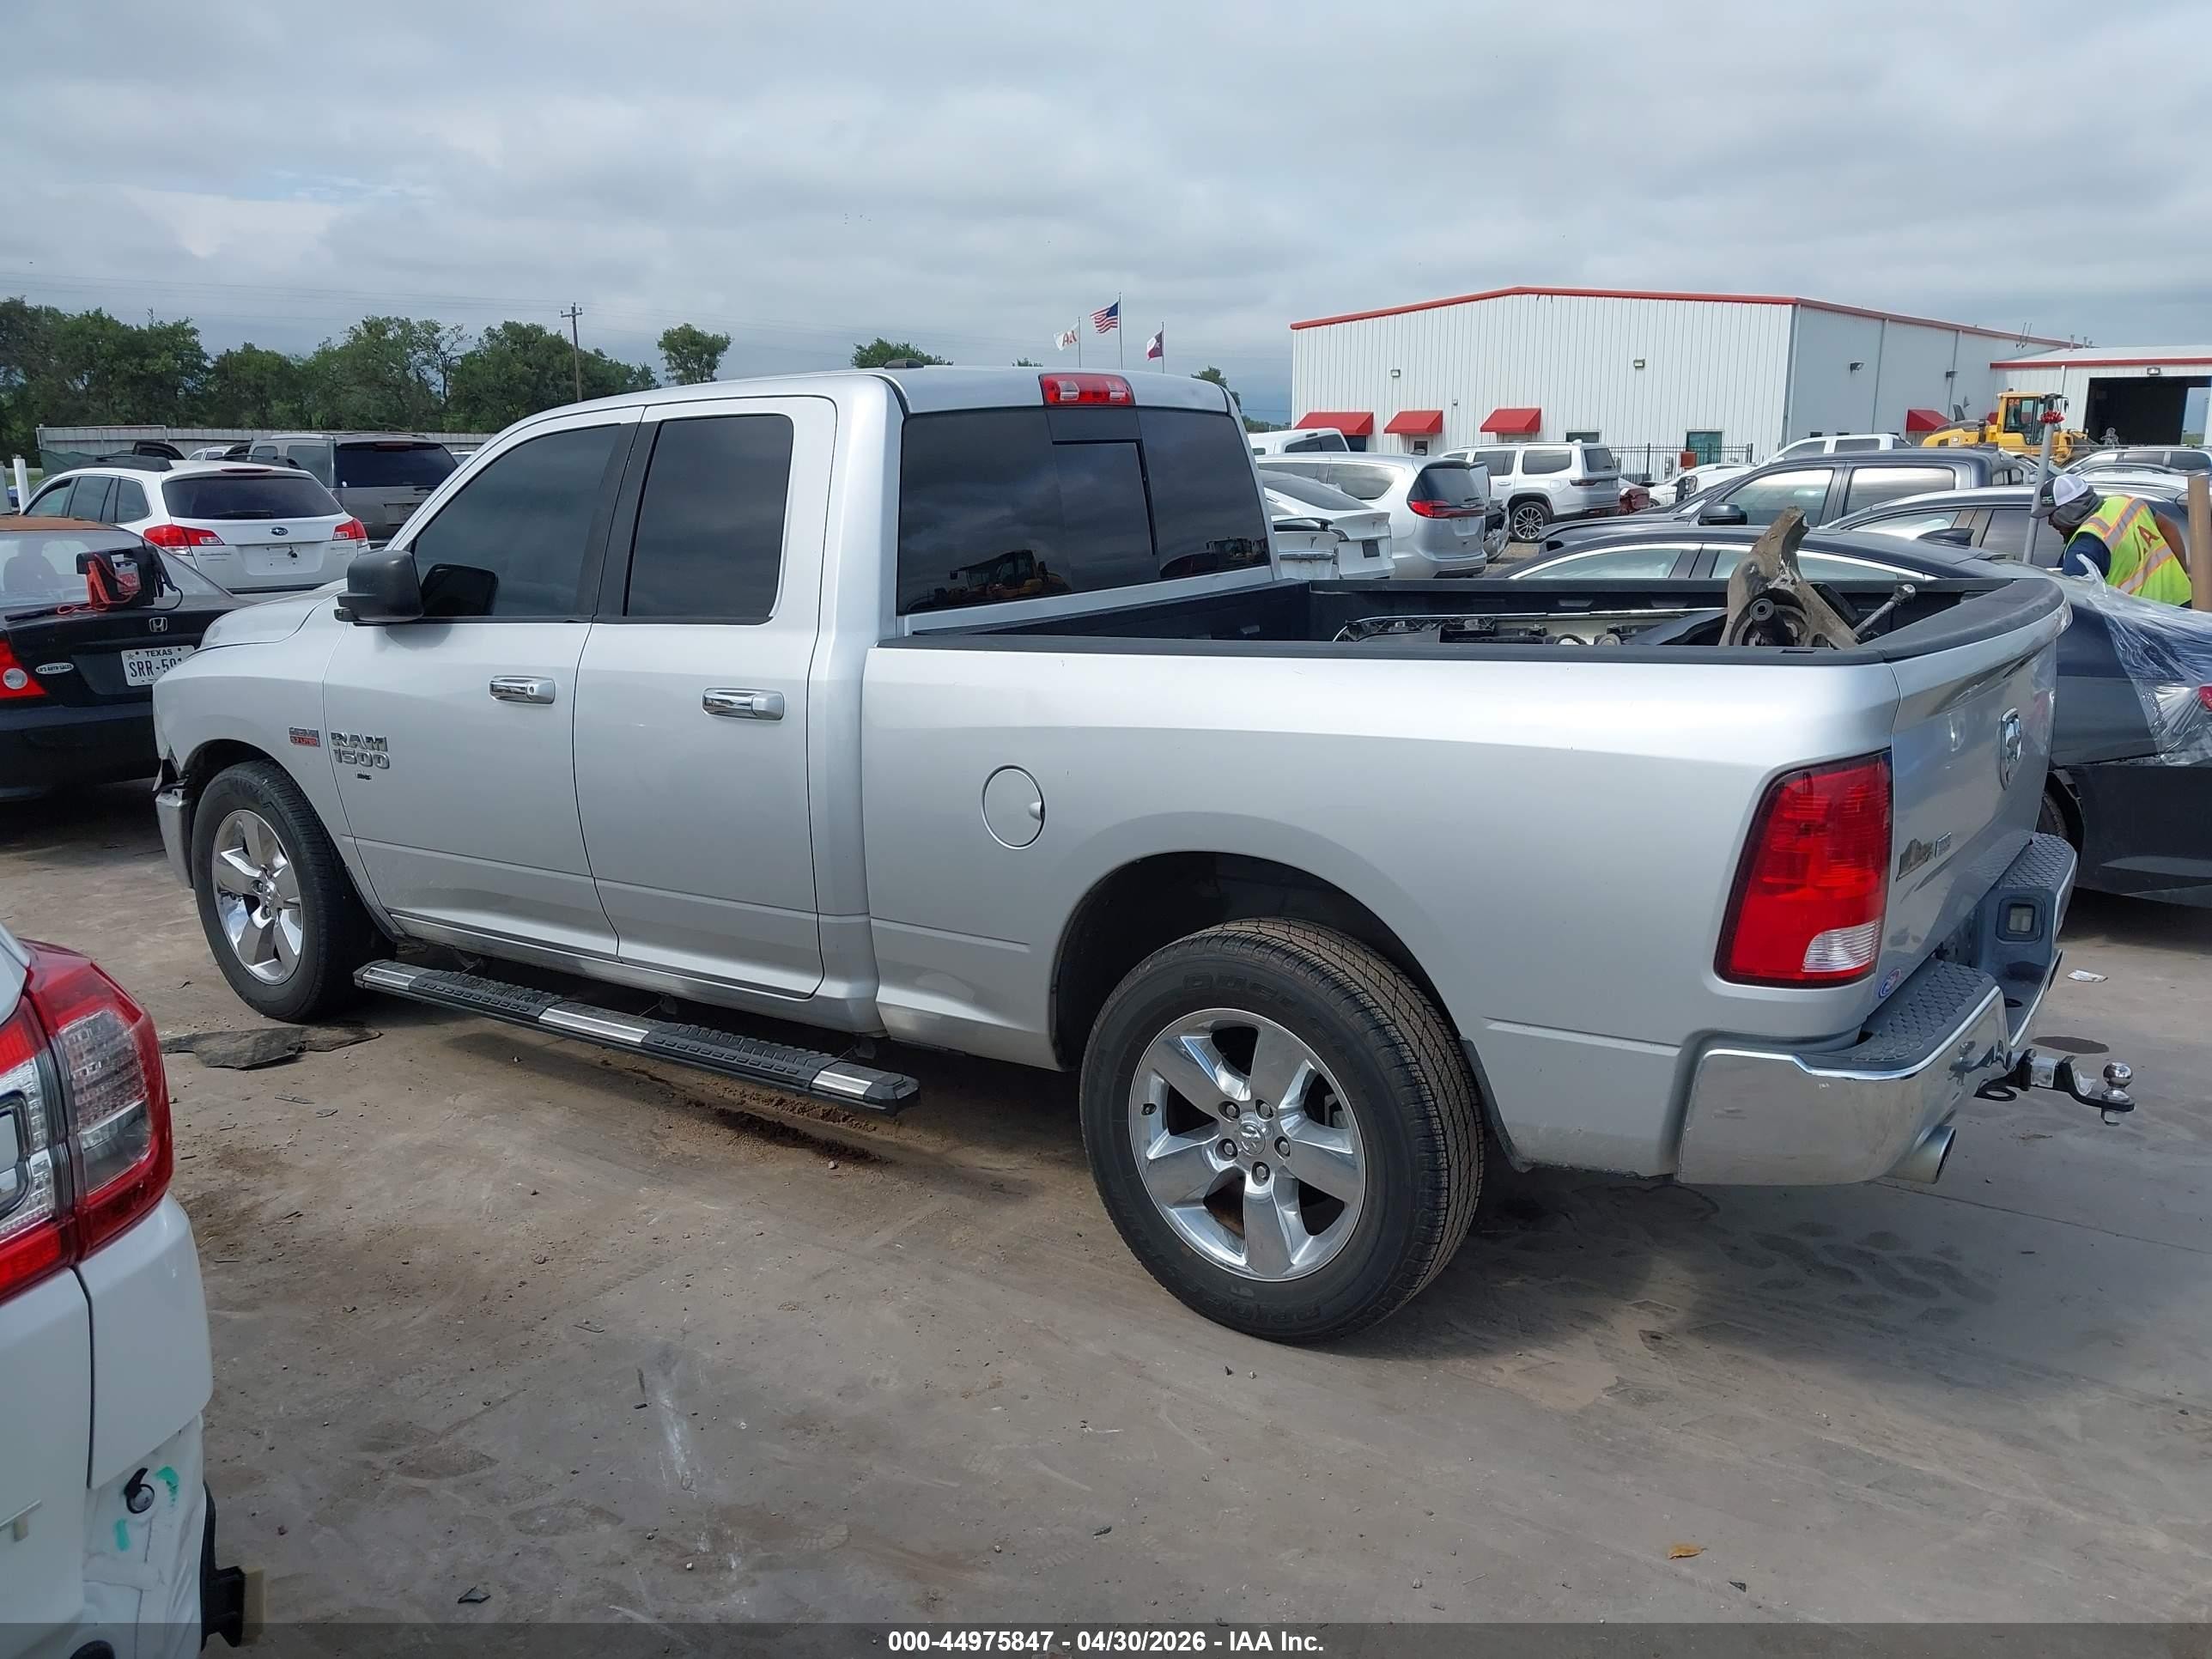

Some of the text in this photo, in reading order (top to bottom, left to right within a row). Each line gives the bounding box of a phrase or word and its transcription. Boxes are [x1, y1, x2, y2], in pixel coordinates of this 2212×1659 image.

[144, 648, 173, 658] TEXAS
[331, 732, 389, 752] RAM
[332, 748, 391, 770] 1500
